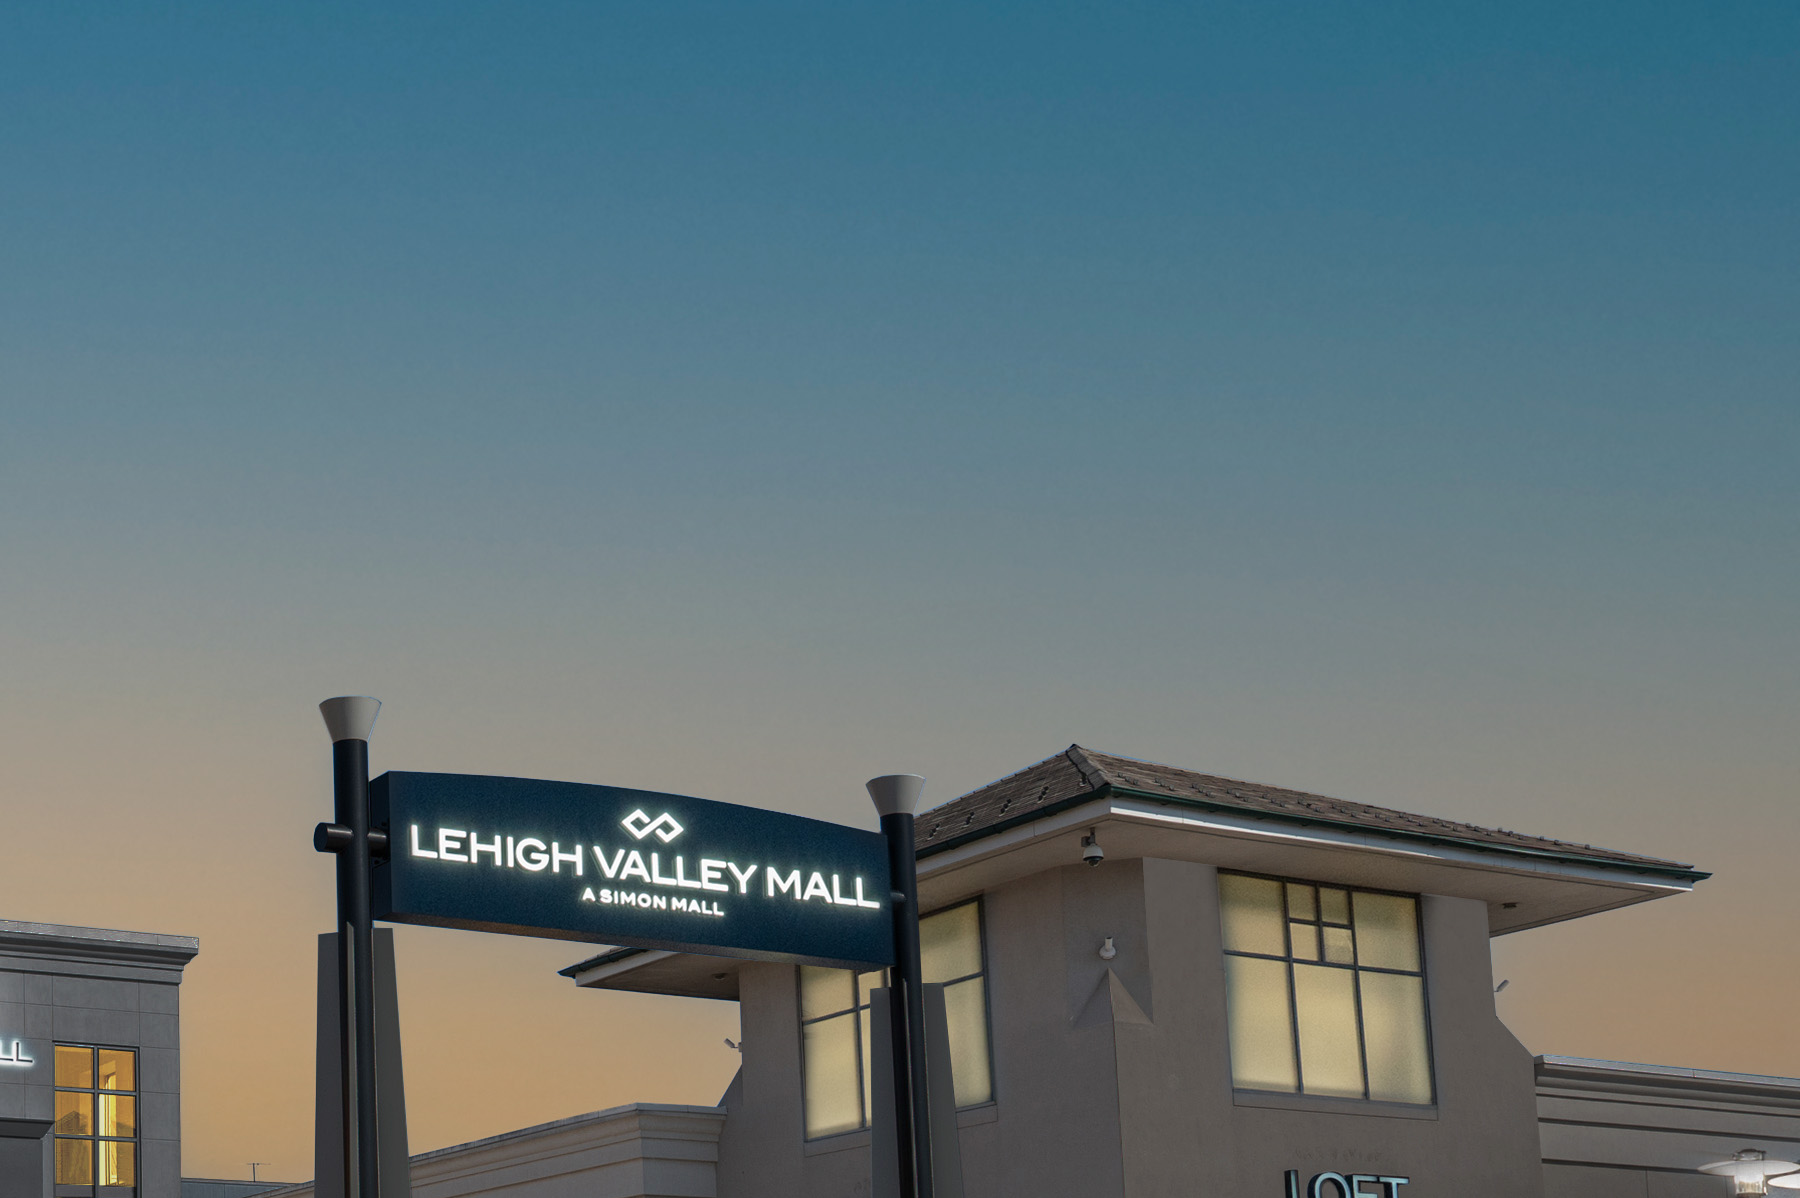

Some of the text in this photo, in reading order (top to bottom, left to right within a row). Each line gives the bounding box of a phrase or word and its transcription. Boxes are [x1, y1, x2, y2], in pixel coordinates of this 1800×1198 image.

[409, 823, 880, 909] LEHIGH VALLEY MALL
[582, 887, 725, 916] A SIMON MALL
